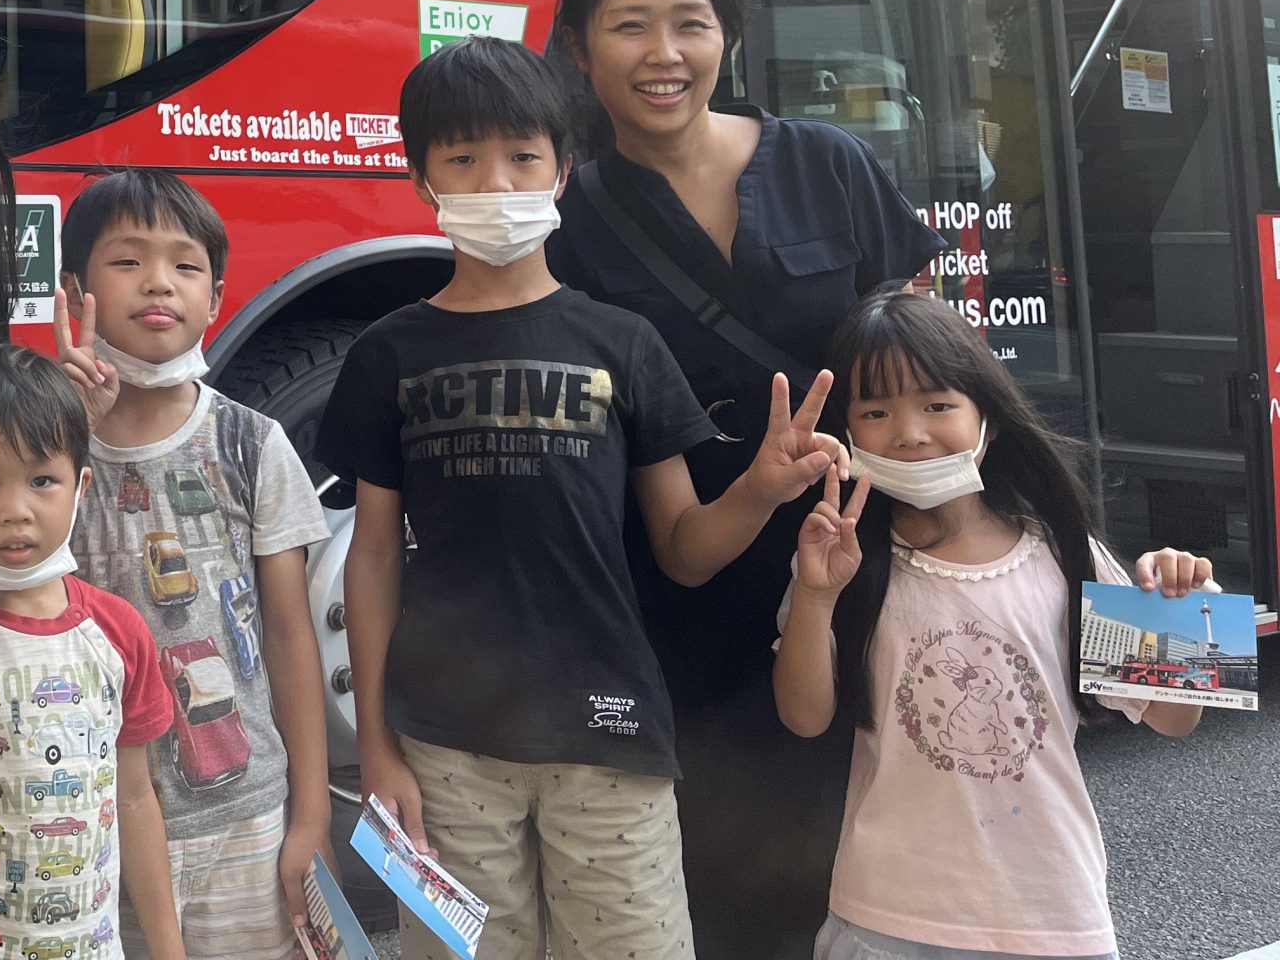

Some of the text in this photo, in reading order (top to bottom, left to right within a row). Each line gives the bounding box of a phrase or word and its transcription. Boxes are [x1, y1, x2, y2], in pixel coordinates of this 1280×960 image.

[158, 103, 342, 142] Tickets available
[350, 116, 390, 135] TICKET
[209, 146, 408, 168] Just board the bus at the
[934, 201, 980, 230] HOP
[986, 202, 1011, 230] off
[944, 295, 1046, 328] us.com
[453, 433, 482, 456] LIFE
[486, 432, 497, 452] A
[501, 433, 550, 454] LIGHT
[553, 436, 591, 458] GAIT
[443, 456, 542, 478] A HIGH TIME
[955, 620, 1002, 645] Mignon
[588, 694, 635, 706] ALWAYS
[594, 702, 631, 713] SPIRIT
[587, 711, 639, 729] Success
[609, 726, 636, 736] GOOD
